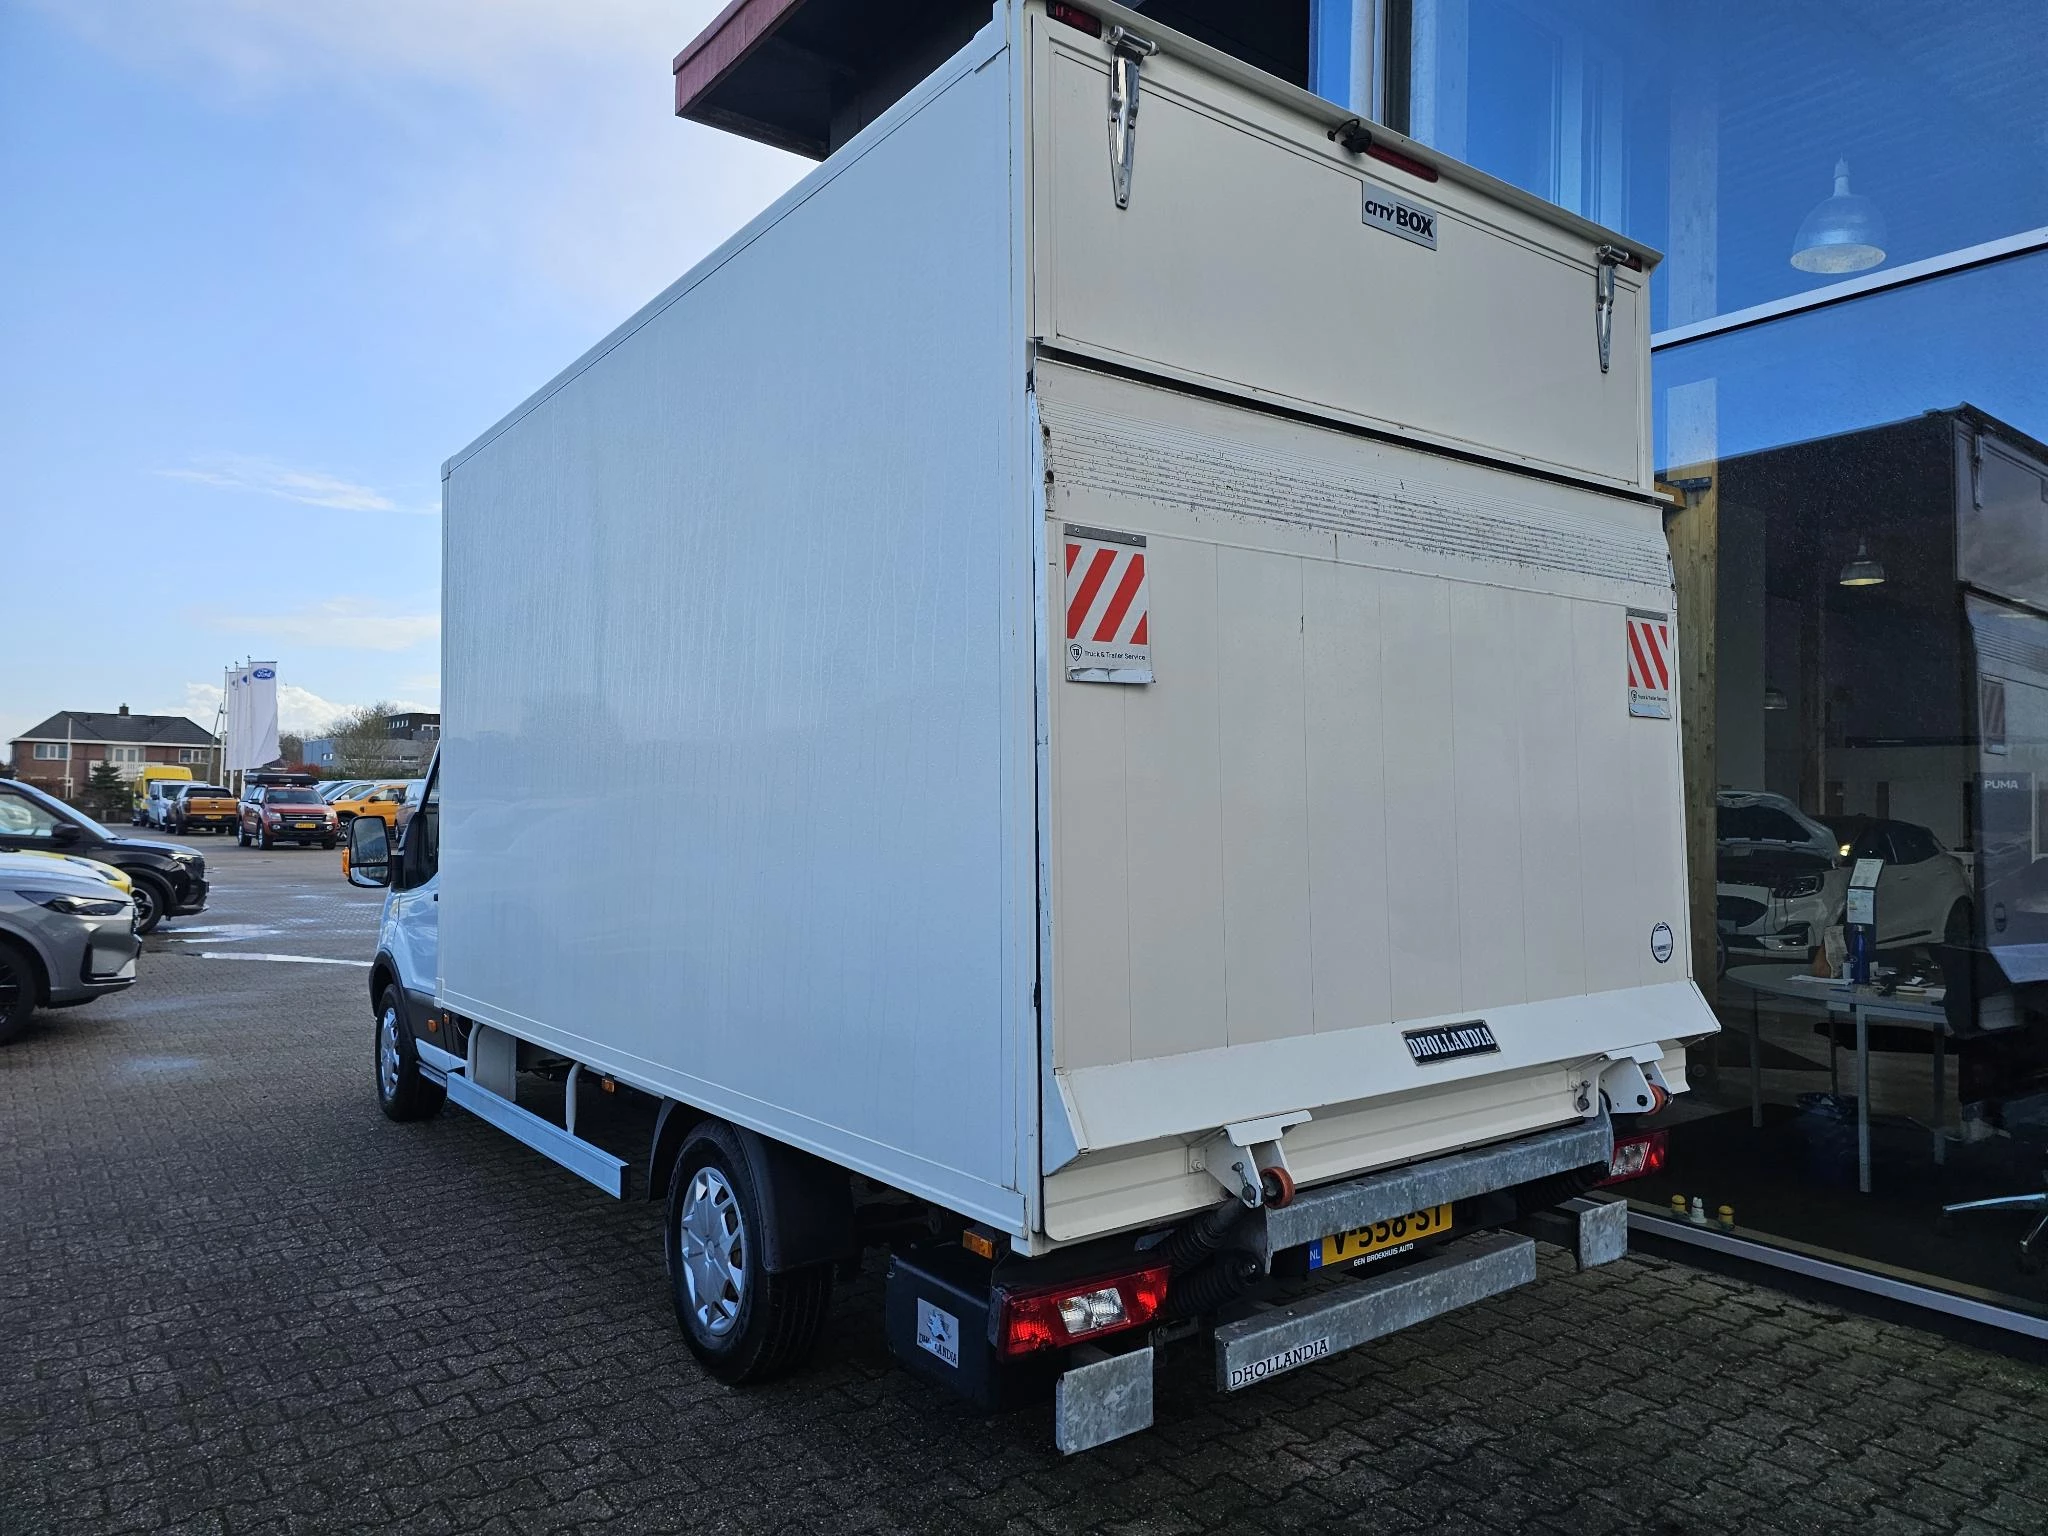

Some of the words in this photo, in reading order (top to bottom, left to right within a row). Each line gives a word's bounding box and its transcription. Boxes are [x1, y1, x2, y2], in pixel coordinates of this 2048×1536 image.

[1365, 200, 1395, 221] CITY
[1396, 206, 1434, 238] BOX
[1085, 650, 1100, 659] Truck
[1125, 652, 1146, 661] Service
[1984, 780, 2019, 789] PUMA
[1406, 1027, 1496, 1058] DHOLLANDIA
[1309, 1248, 1321, 1261] NL
[1353, 1256, 1366, 1267] EEN
[1366, 1248, 1399, 1263] BROEKHUIS
[1399, 1242, 1414, 1254] AUTO
[1231, 1339, 1329, 1387] DHOLLANDIA
